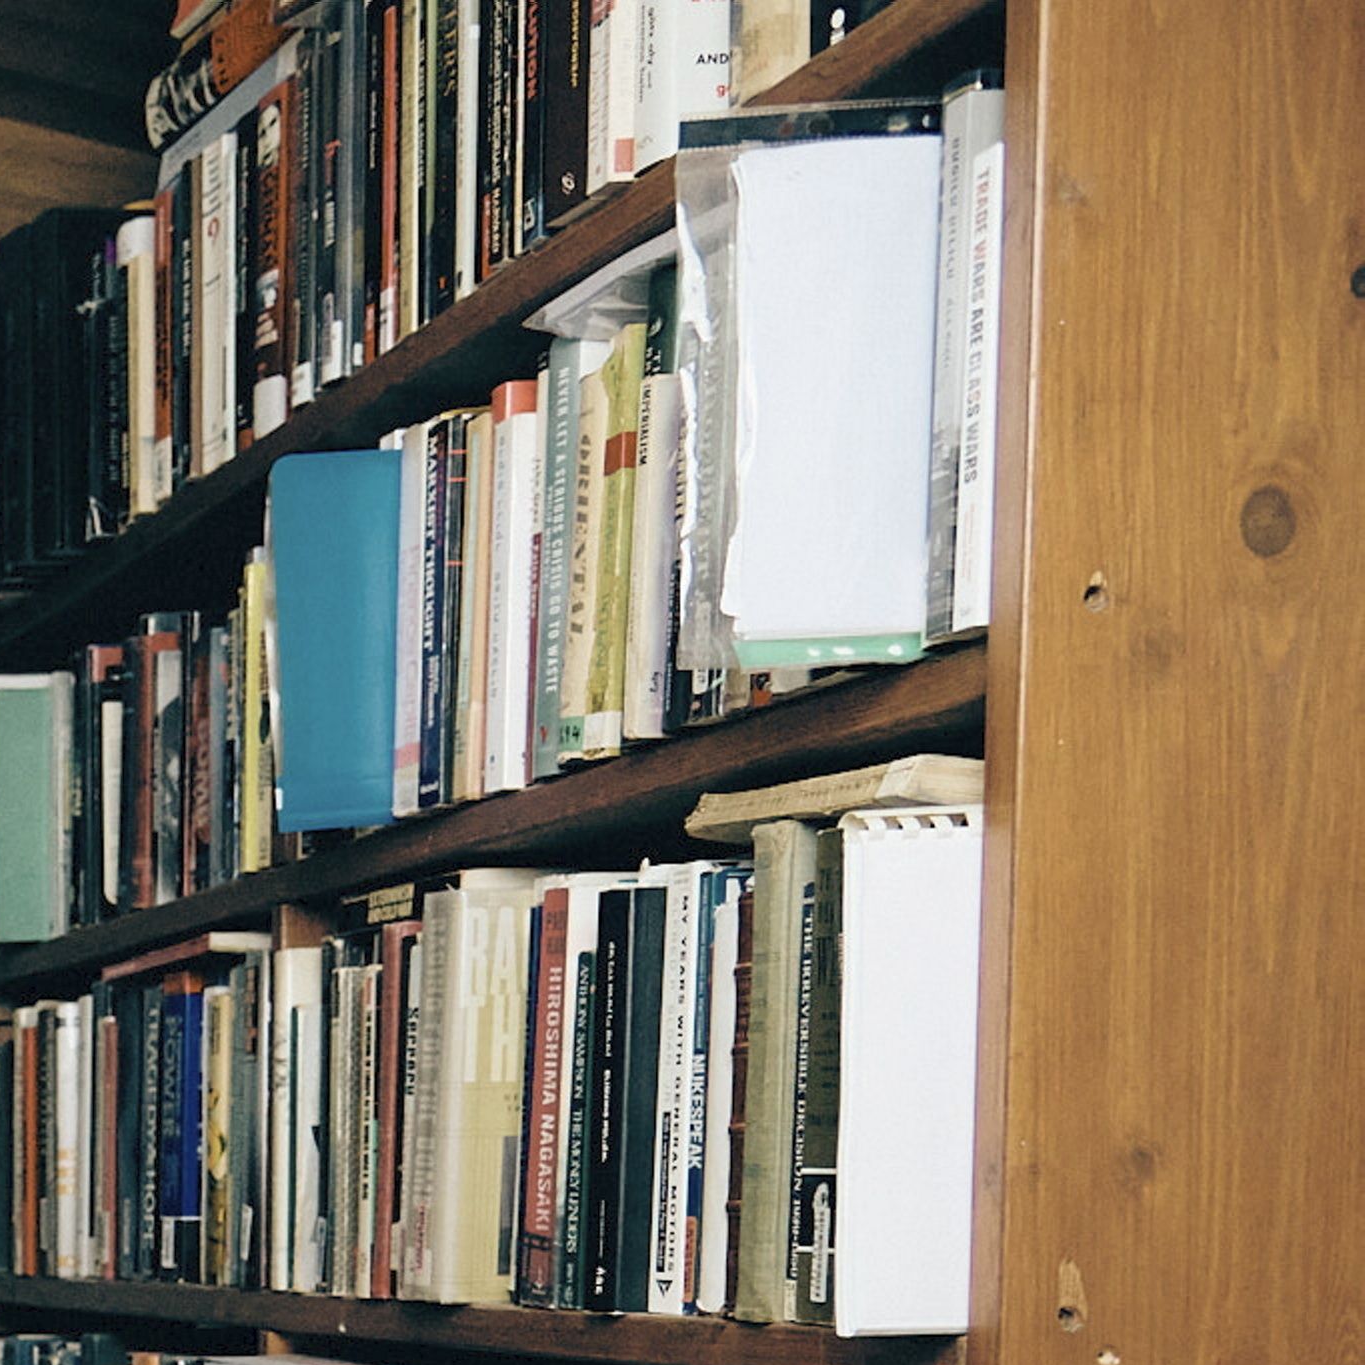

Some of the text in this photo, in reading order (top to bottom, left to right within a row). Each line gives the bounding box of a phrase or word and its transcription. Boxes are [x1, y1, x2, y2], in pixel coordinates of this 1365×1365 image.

[973, 169, 990, 235] TRADE
[971, 241, 987, 303] WARS
[969, 308, 984, 346] ARE
[966, 352, 983, 417] CLASS
[638, 384, 653, 467] IMPERIALISM
[963, 421, 980, 485] WARS
[425, 436, 439, 542] MARXIST
[544, 367, 571, 694] NEVER LET A SERIOUS CRISIS GO TO WASTE
[422, 546, 437, 651] THOUGHT
[681, 896, 690, 923] MY
[802, 913, 815, 953] THE
[575, 963, 590, 1029] ANTHONY
[678, 939, 688, 1004] YEARS
[572, 1032, 587, 1099] SAMPSON
[675, 1016, 685, 1066] WITH
[795, 959, 813, 1095] IRREVERSIBLE
[145, 1003, 159, 1143] TRAGEDY
[163, 1016, 177, 1137] POWER
[534, 966, 563, 1232] HIROSHIMA NAGASAKI
[688, 1053, 707, 1169] NUKESPEAK
[570, 1109, 583, 1136] THE
[671, 1077, 682, 1172] GENERAL
[792, 1100, 806, 1190] DECISION
[142, 1170, 158, 1250] HOPE
[667, 1186, 678, 1272] MOTORS
